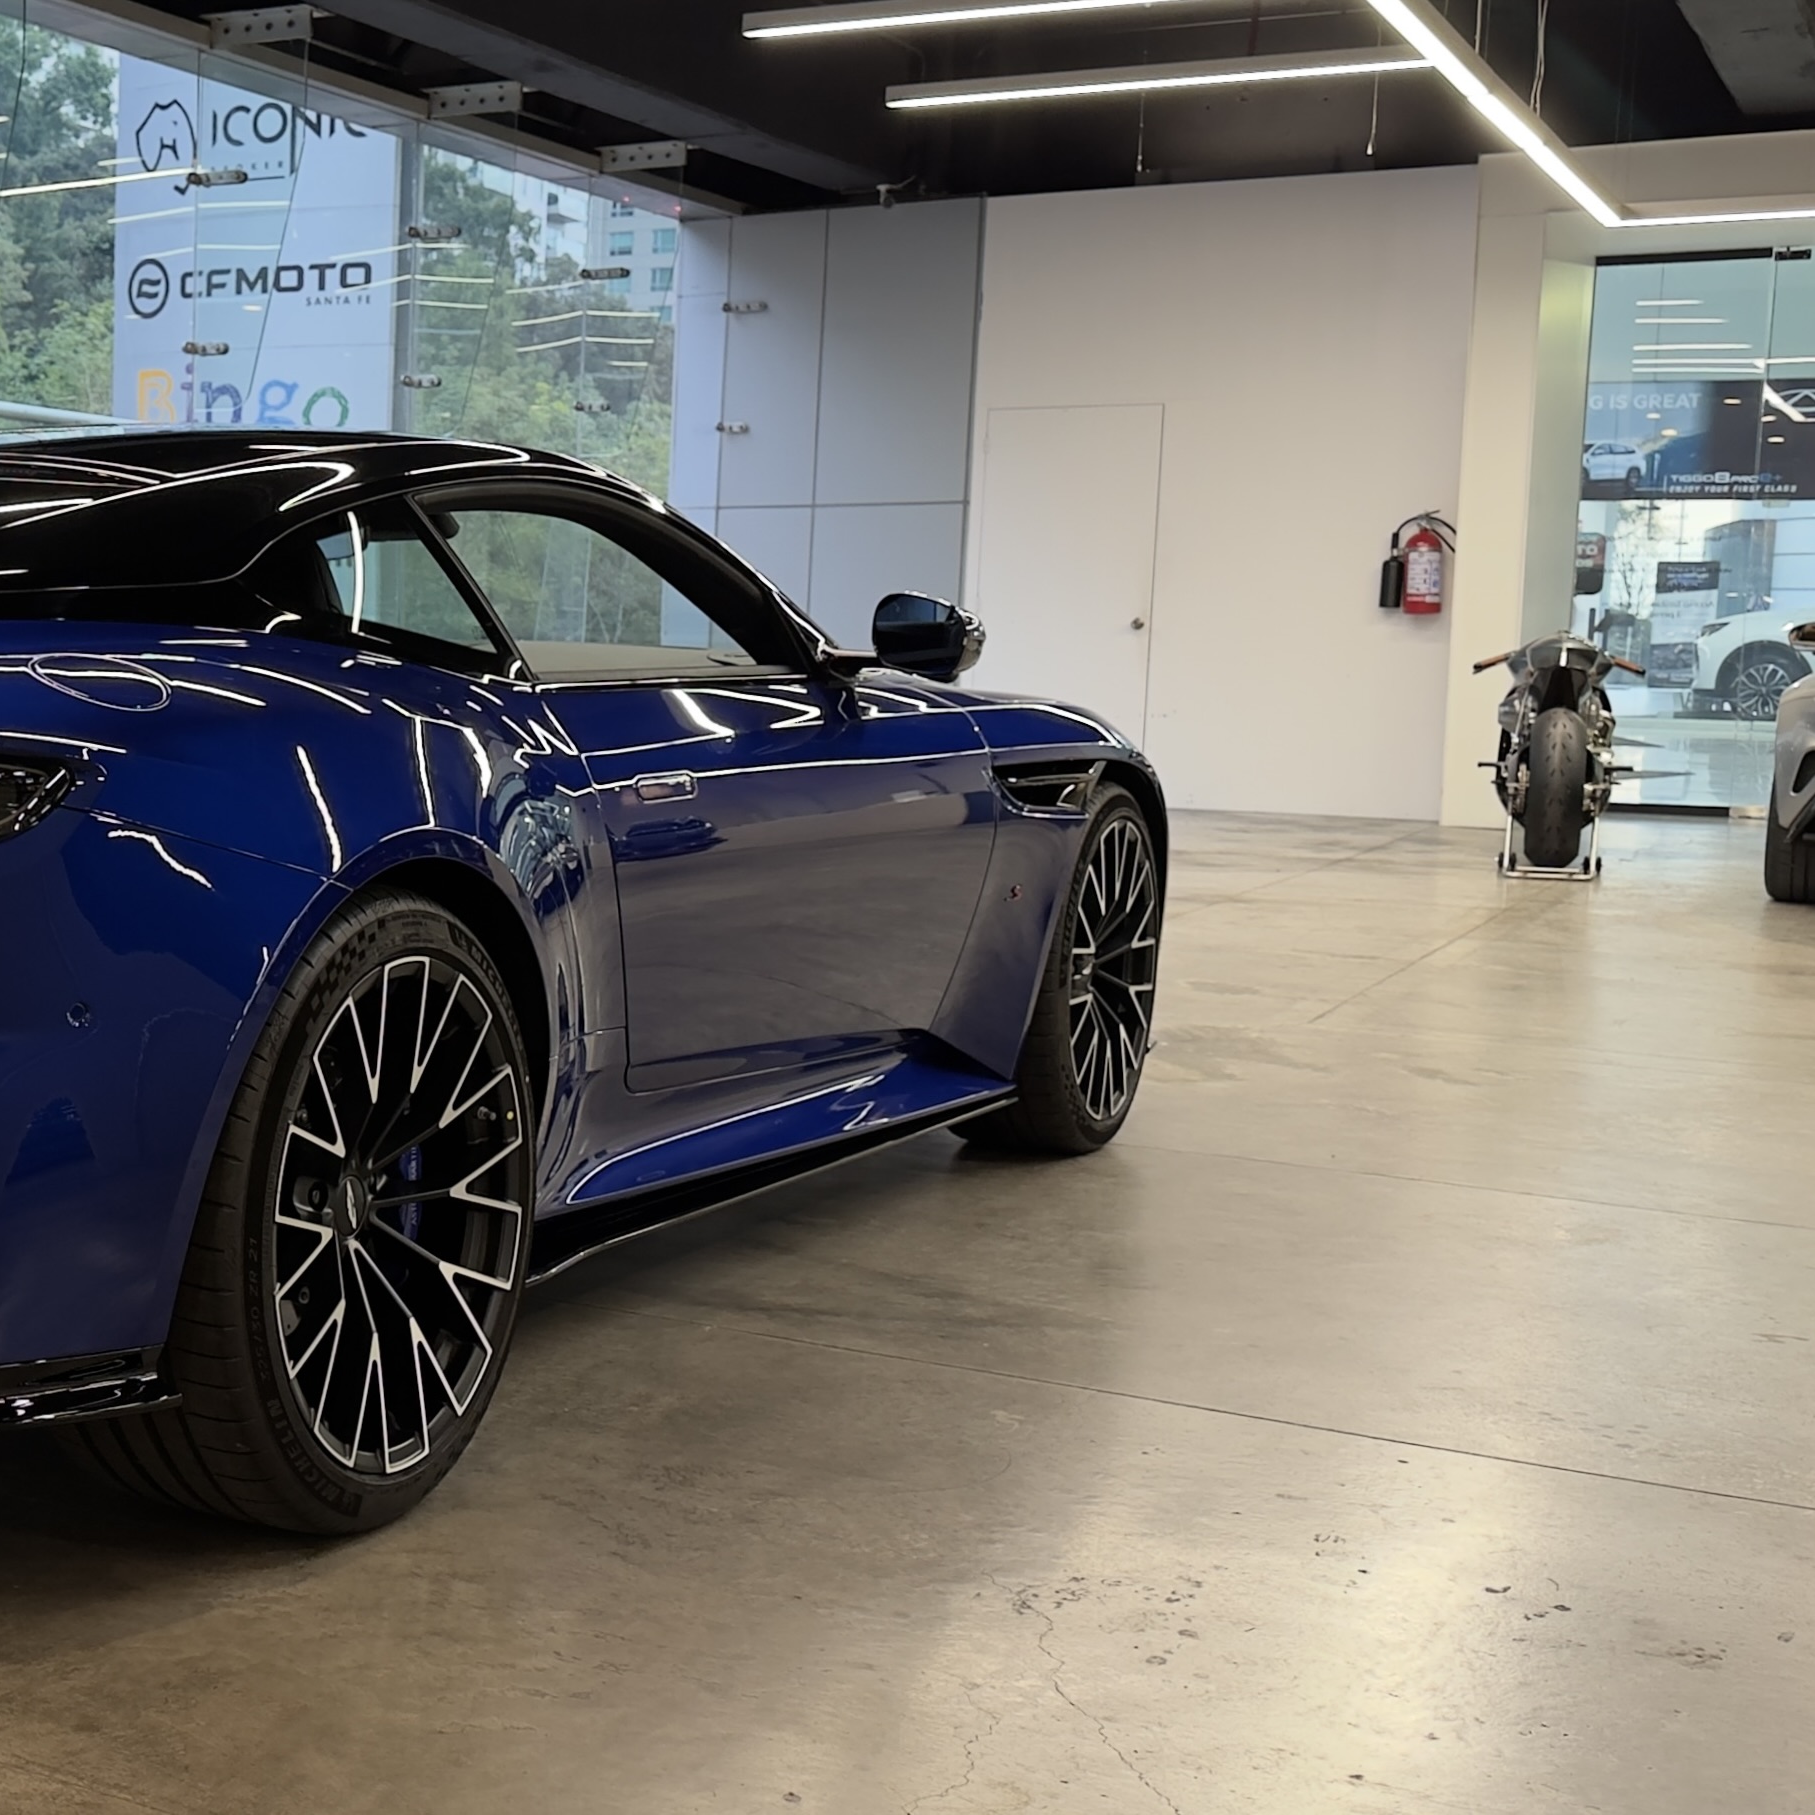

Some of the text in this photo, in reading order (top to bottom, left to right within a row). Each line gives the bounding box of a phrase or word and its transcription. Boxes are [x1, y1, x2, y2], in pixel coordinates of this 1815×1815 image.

[180, 262, 372, 299] CFMOTO
[305, 294, 371, 307] SANTA FE
[1609, 393, 1628, 410] IS
[1633, 392, 1700, 410] GREAT
[1732, 484, 1762, 493] FIRST
[266, 1398, 341, 1501] MICHELIN
